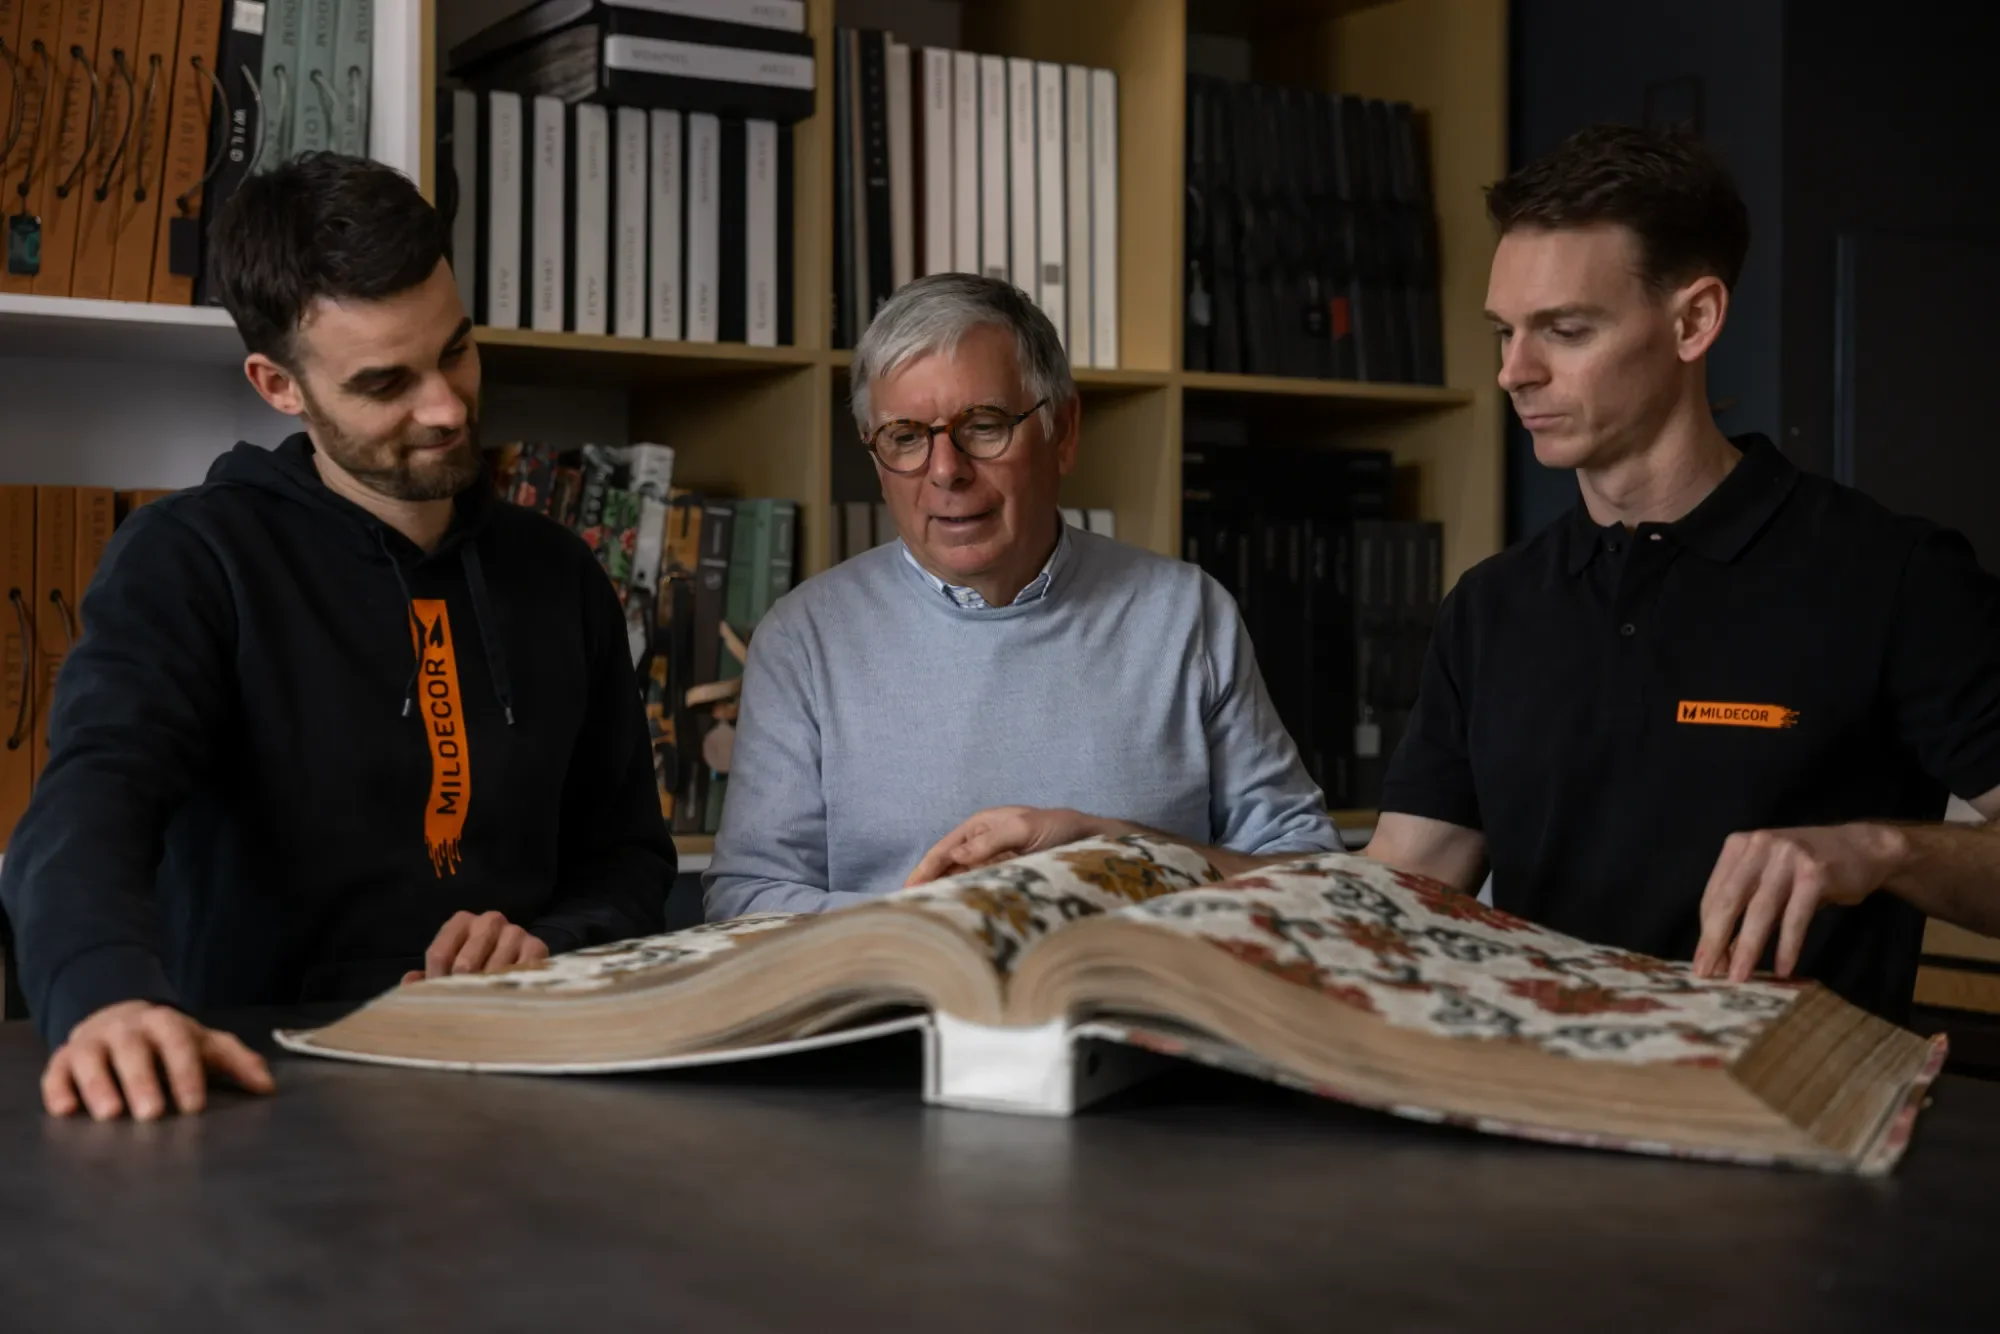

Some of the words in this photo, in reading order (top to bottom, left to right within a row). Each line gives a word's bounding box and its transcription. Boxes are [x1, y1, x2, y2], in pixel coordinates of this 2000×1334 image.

[230, 108, 248, 163] WILD
[424, 658, 461, 816] MILDECOR
[1700, 706, 1769, 722] MILDECOR
